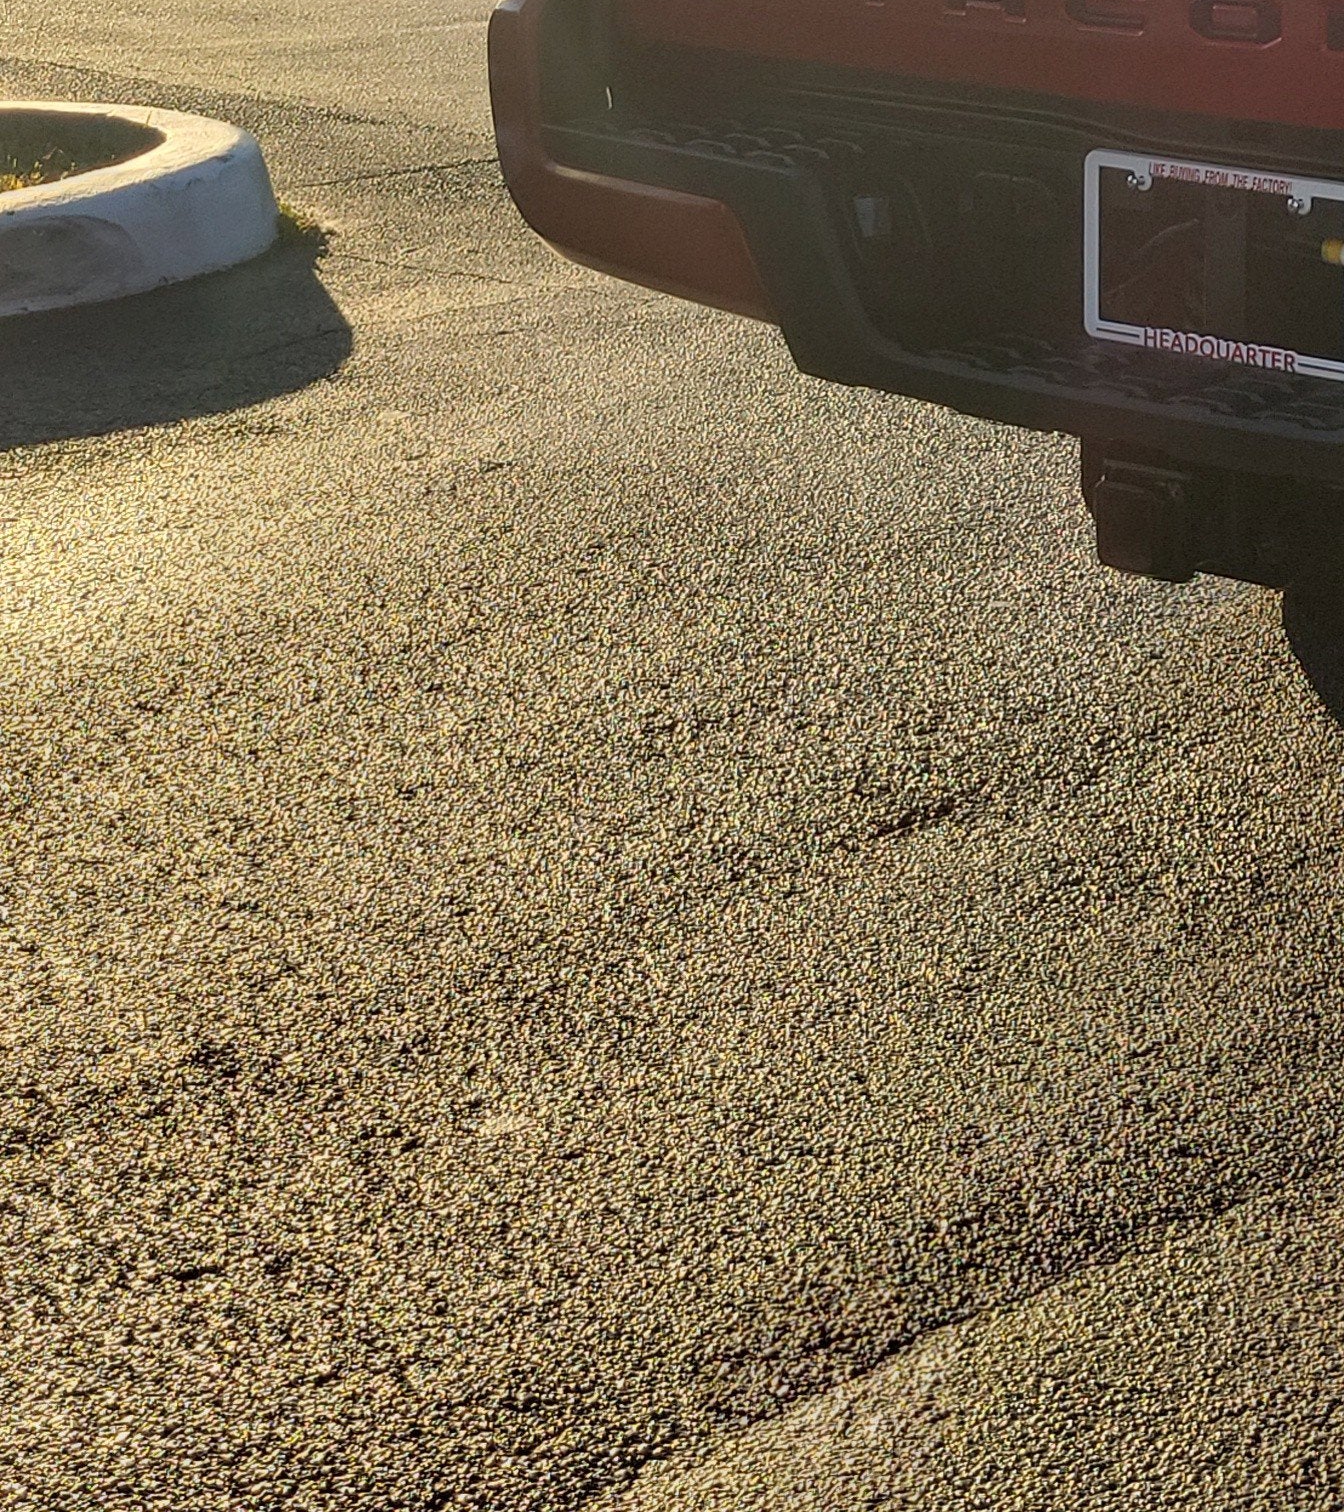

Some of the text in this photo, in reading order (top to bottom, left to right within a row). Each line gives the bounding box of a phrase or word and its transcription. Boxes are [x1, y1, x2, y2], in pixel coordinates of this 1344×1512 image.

[1149, 161, 1165, 176] LIKE
[1170, 165, 1200, 183] BUYING
[1205, 169, 1229, 187] FROM
[1233, 173, 1249, 189] THE
[1142, 326, 1297, 373] HEADQUARTER
